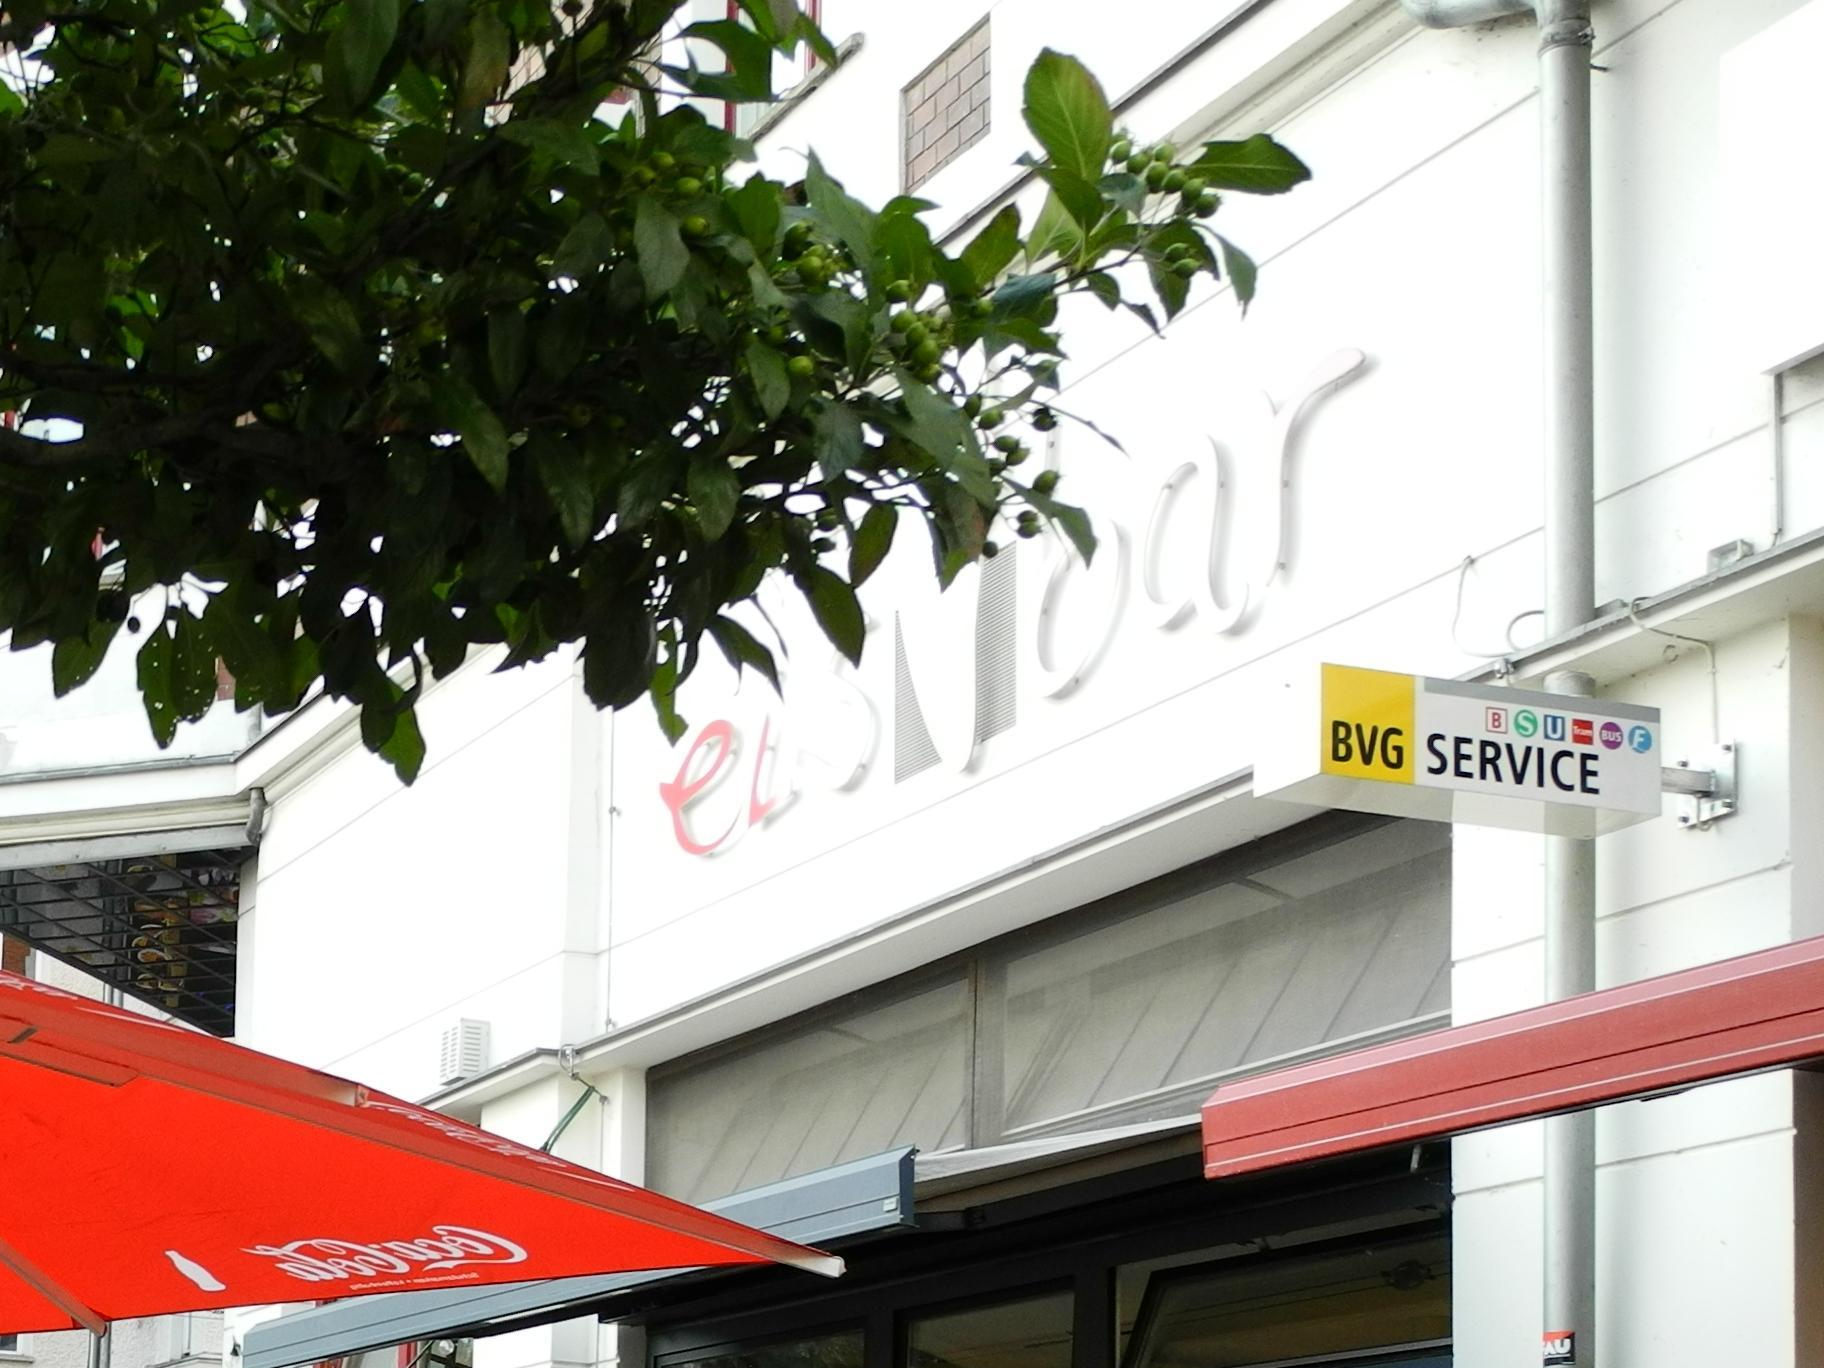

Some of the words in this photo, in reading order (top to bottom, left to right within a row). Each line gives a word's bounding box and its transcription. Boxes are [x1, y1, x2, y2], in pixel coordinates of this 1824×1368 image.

[1331, 719, 1405, 770] BVG
[1426, 733, 1601, 796] SERVICE
[1600, 729, 1623, 743] BUS
